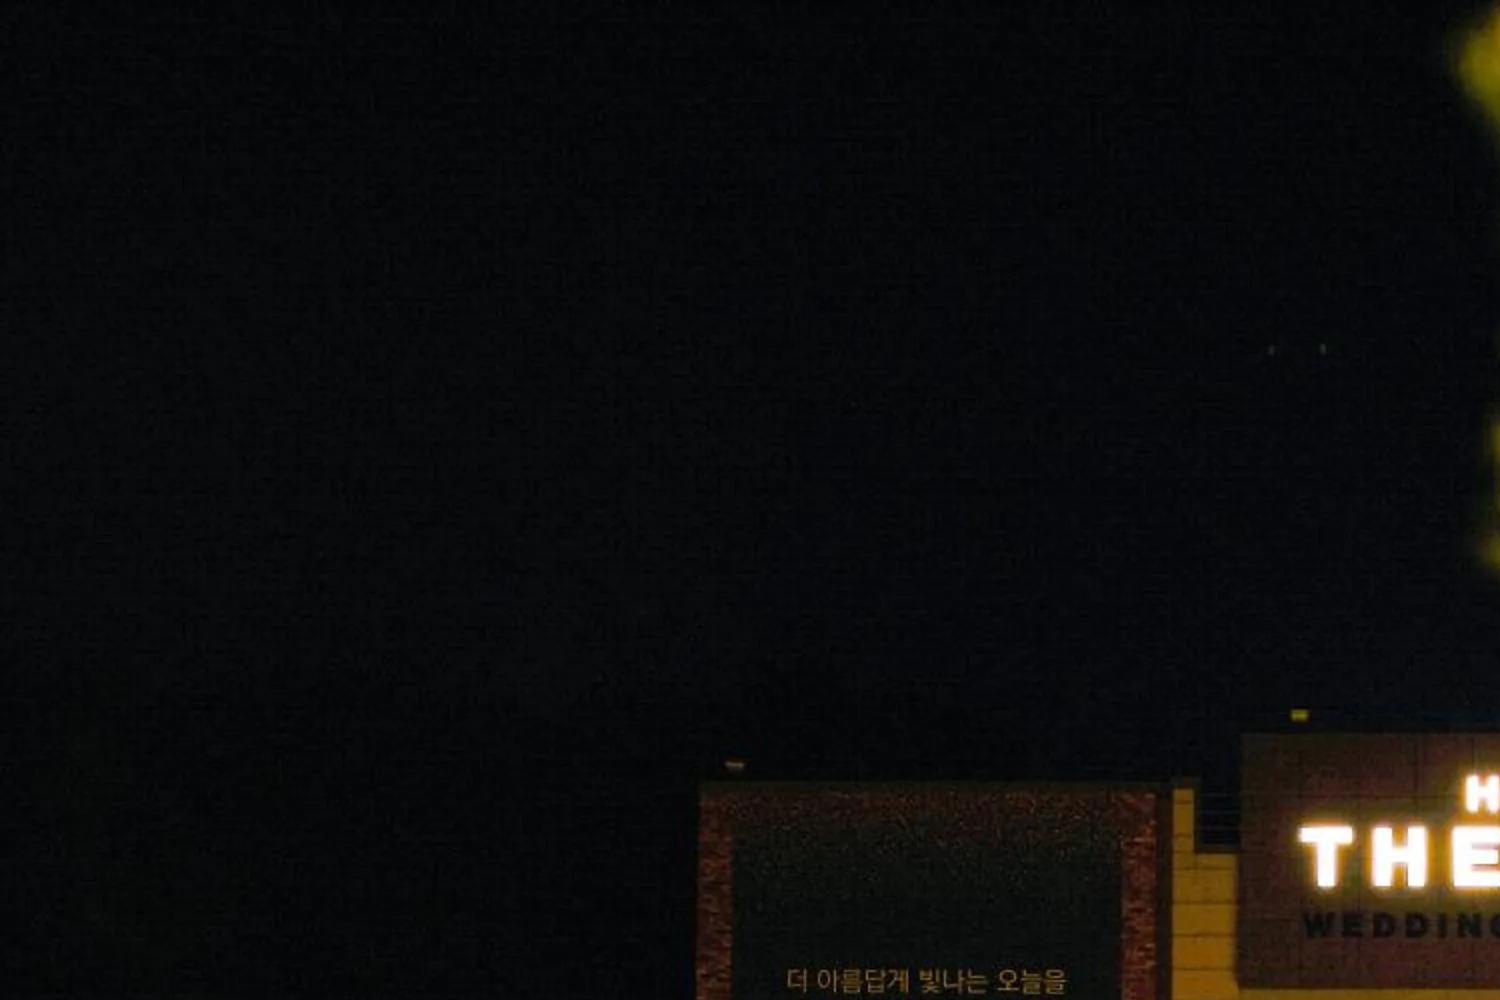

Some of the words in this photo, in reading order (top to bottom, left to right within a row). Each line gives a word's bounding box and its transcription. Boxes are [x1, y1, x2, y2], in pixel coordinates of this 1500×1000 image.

[787, 968, 807, 993] 더
[818, 967, 910, 993] 아름답게
[919, 968, 989, 993] 빛나는
[997, 968, 1068, 993] 오늘을
